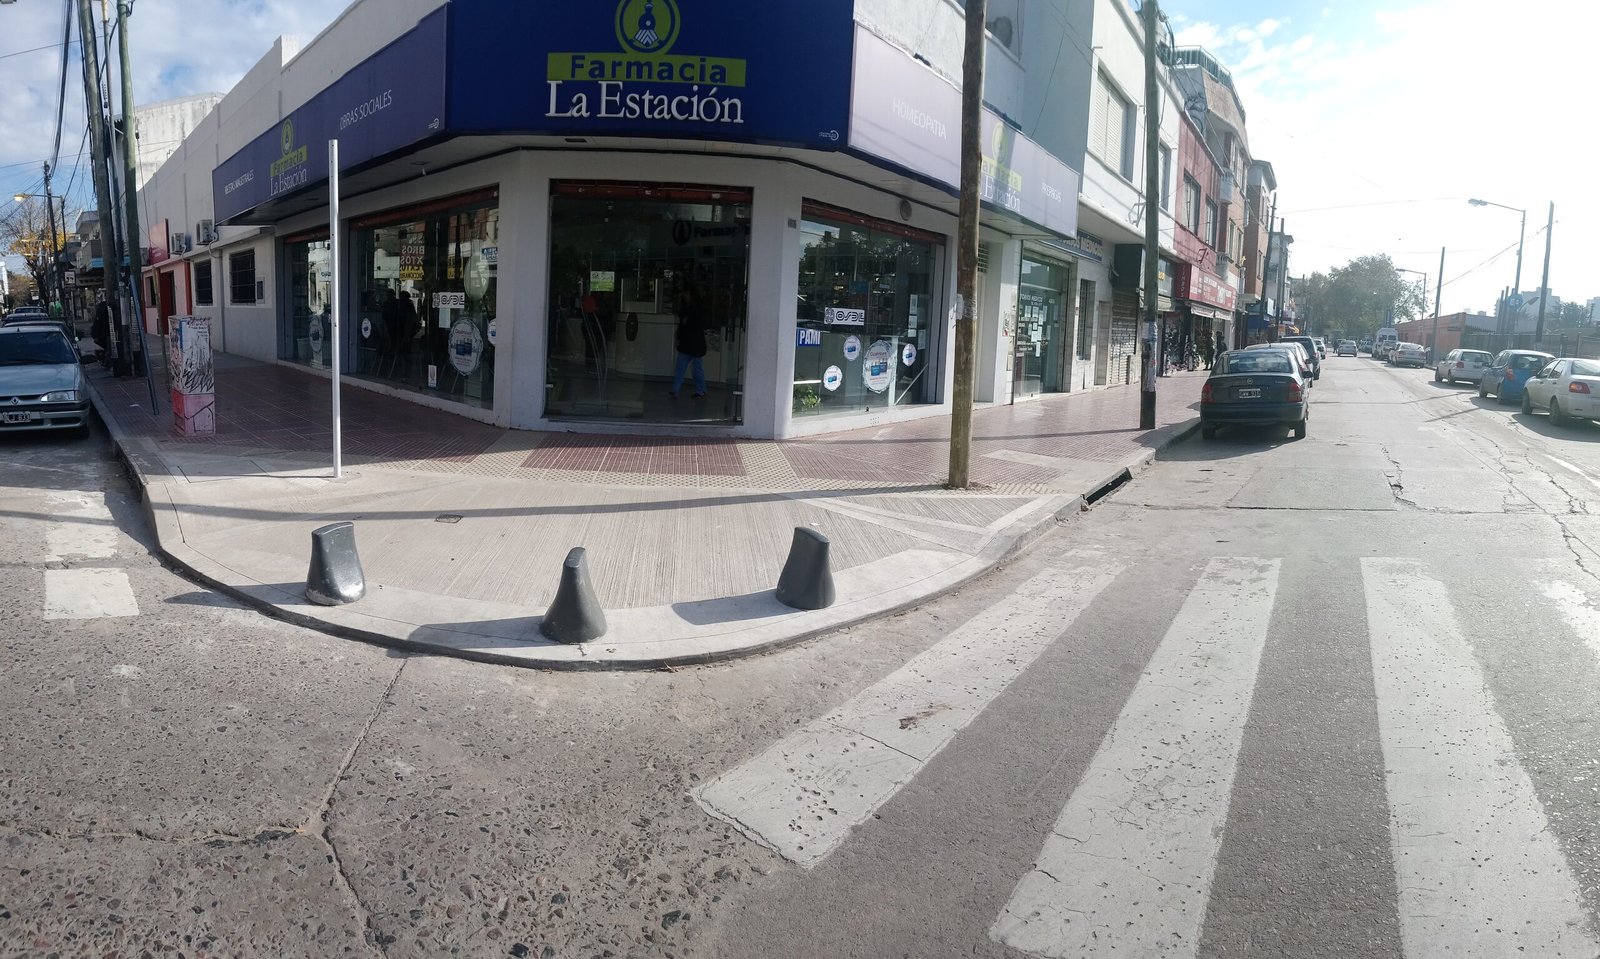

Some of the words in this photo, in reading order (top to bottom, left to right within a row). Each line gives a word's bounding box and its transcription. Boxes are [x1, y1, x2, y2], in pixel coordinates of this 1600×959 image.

[570, 55, 727, 84] Farmacia
[340, 108, 358, 131] OBRAS
[360, 89, 392, 121] SOCIALES
[545, 80, 591, 119] La
[597, 80, 744, 124] Estación
[892, 97, 947, 140] HOMEOPATIA
[835, 310, 865, 322] OSDE
[799, 330, 821, 345] PAMI
